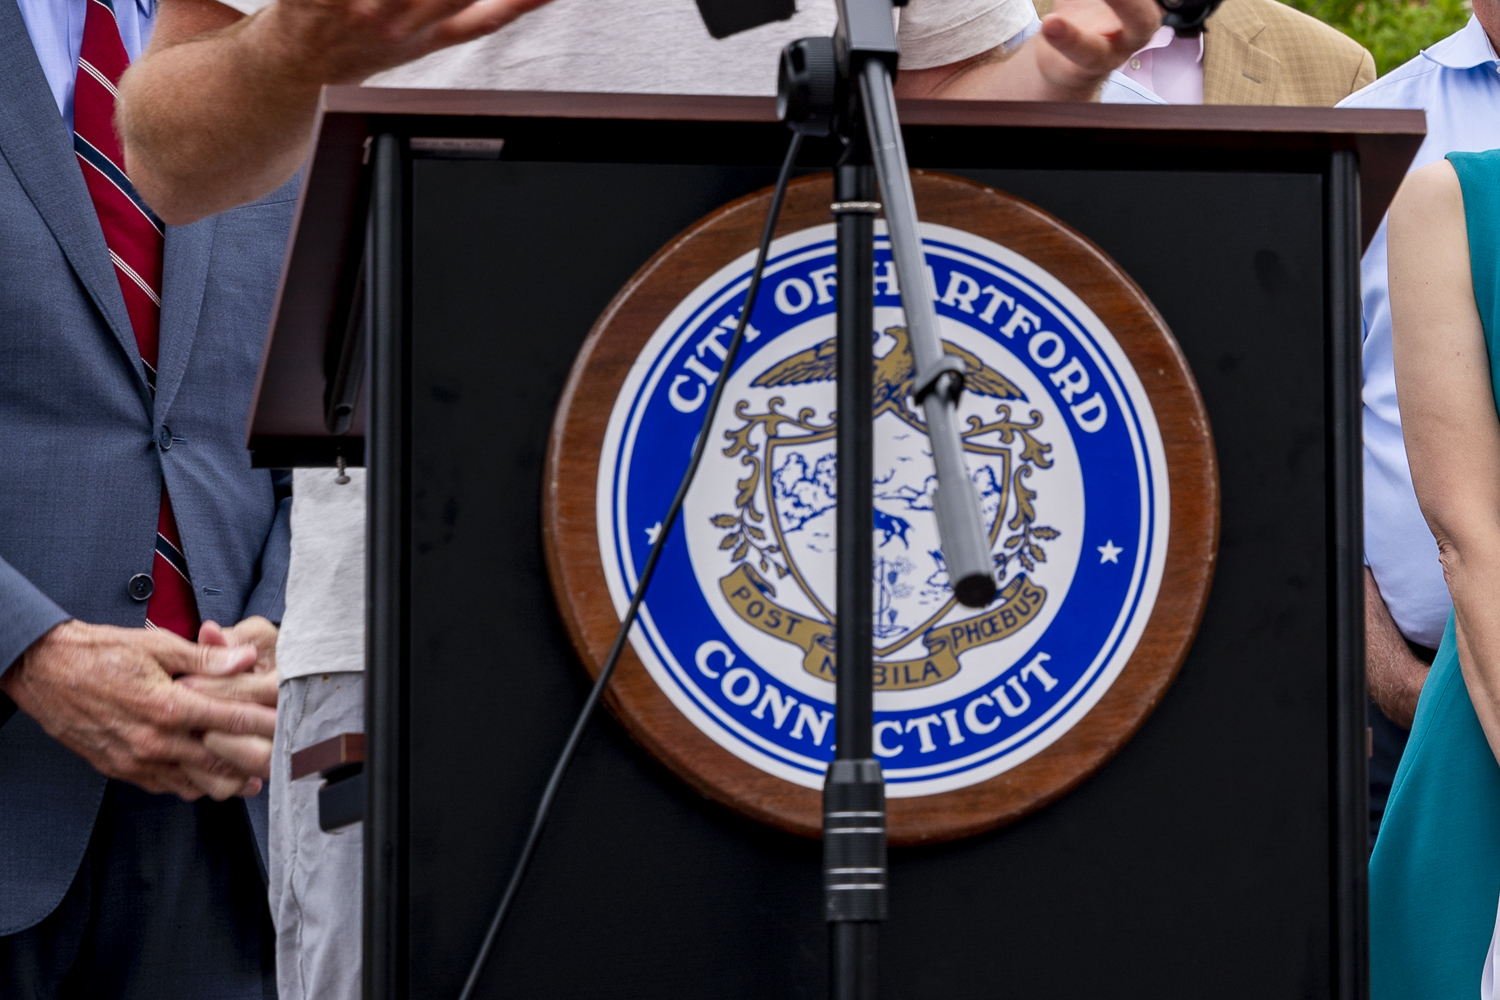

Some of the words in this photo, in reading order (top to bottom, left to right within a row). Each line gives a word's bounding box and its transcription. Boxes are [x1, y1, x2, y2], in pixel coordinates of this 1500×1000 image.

[668, 305, 761, 413] CITY
[774, 264, 838, 315] OF
[731, 586, 803, 636] POST
[819, 658, 942, 686] NBILA
[694, 639, 1059, 758] CONNCTICUT
